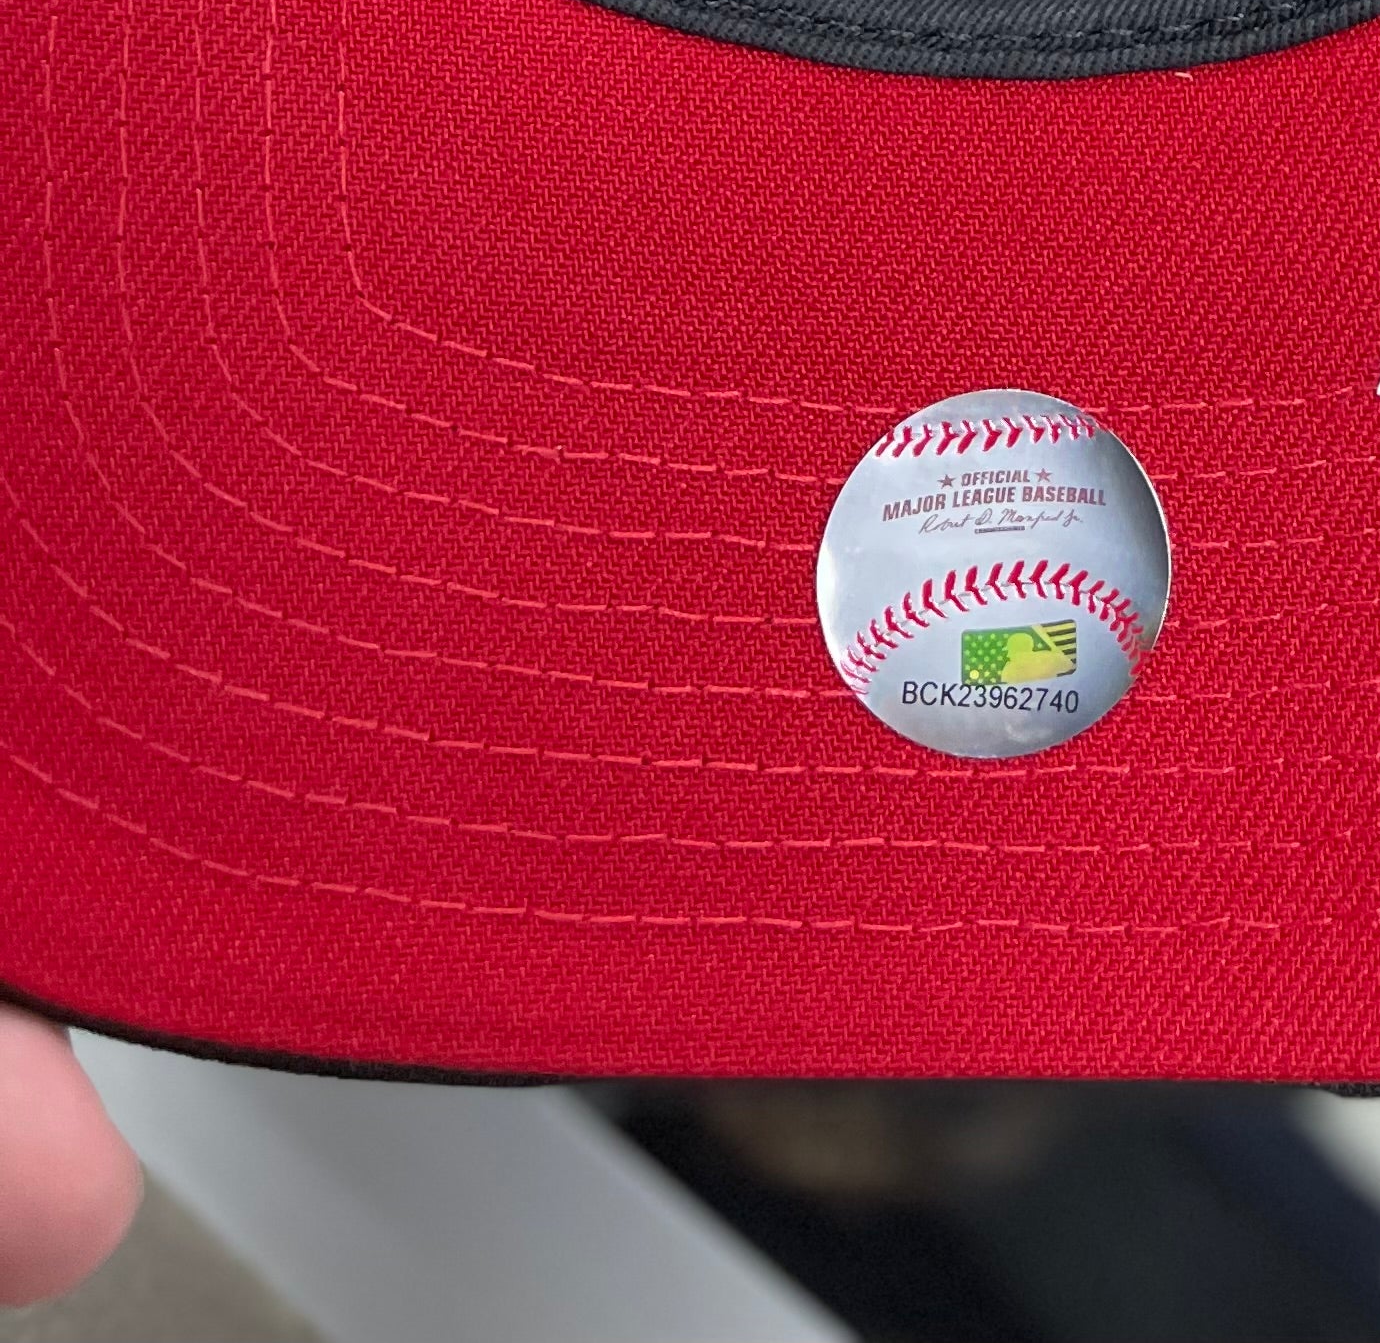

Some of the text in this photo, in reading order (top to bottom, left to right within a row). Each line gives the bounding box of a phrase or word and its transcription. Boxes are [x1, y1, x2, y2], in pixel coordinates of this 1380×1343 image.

[961, 469, 1031, 487] OFFICIAL
[882, 486, 1107, 522] MAJOR LEAGUE BASEBALL
[902, 681, 1080, 714] BCK23962740
